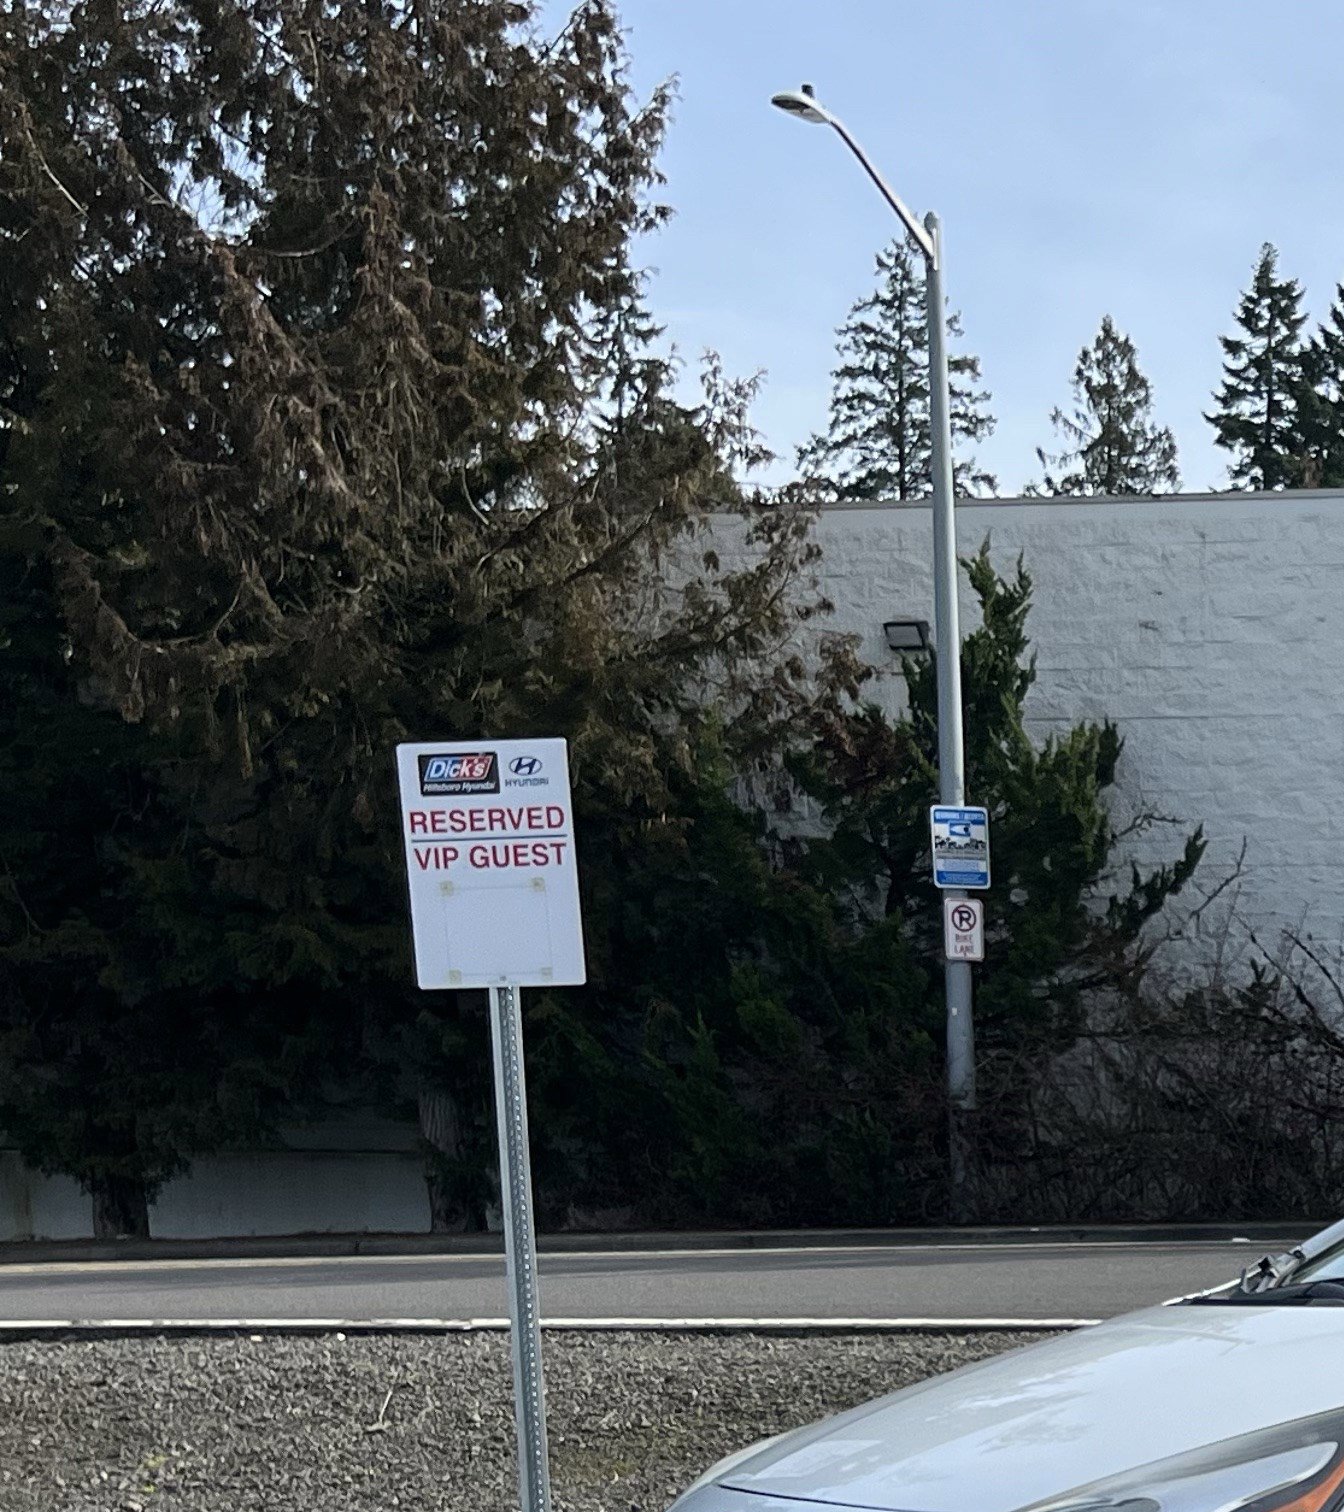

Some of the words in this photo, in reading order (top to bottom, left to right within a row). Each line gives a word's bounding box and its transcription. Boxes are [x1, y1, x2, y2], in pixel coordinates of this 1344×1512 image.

[462, 781, 496, 792] Hyundai
[505, 777, 549, 788] HYUNDAI
[410, 806, 565, 834] RESERVED
[414, 846, 459, 870] VIP
[469, 843, 567, 869] GUEST
